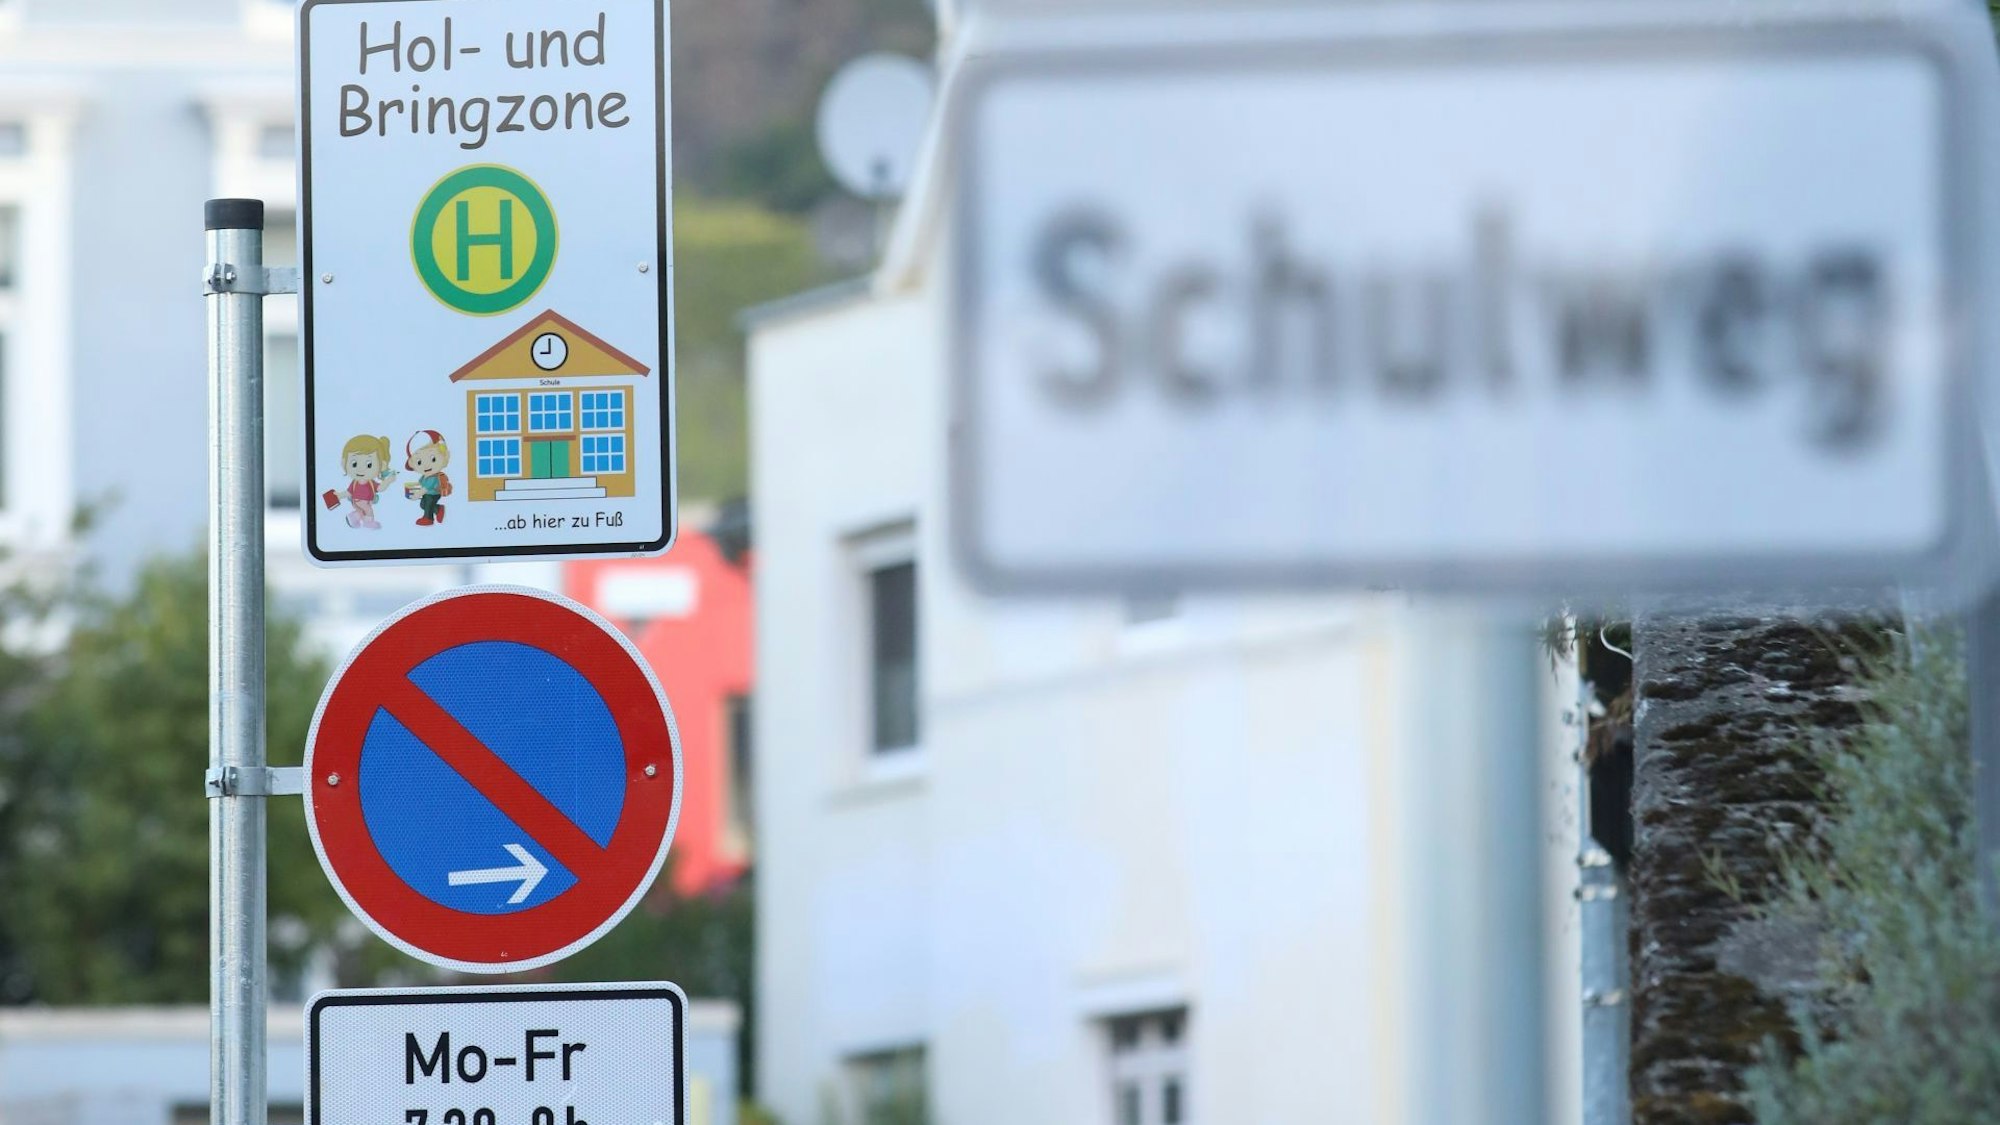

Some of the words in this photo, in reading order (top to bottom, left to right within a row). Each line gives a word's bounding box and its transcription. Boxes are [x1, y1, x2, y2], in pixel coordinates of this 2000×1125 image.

[359, 16, 481, 76] Hol-
[505, 11, 606, 69] und
[339, 83, 630, 150] Bringzone
[455, 198, 514, 282] H
[1028, 195, 1892, 455] Schulweg
[539, 378, 561, 386] Schule
[494, 514, 527, 531] ...ab
[532, 513, 566, 529] hier
[571, 516, 590, 528] zu
[595, 510, 624, 528] Fuß
[405, 1029, 588, 1085] Mo-Fr
